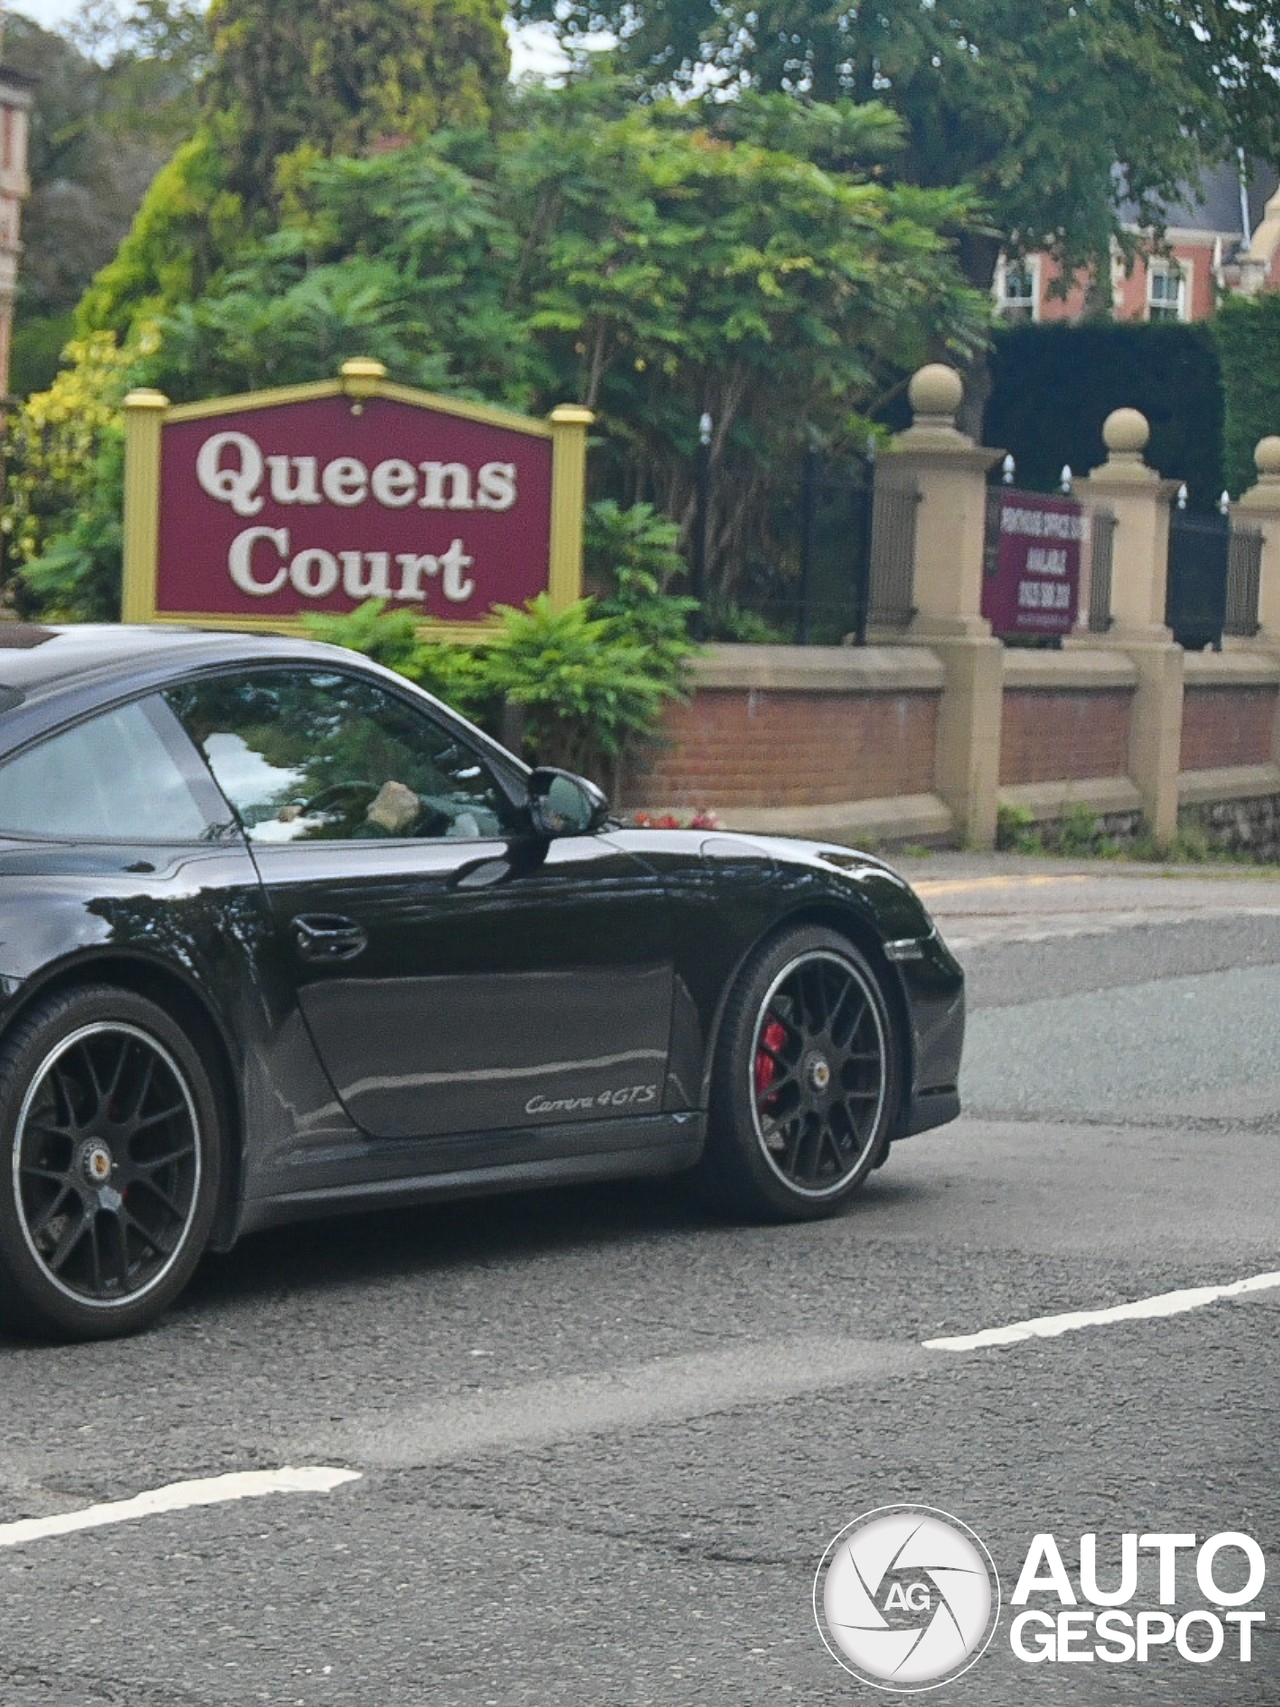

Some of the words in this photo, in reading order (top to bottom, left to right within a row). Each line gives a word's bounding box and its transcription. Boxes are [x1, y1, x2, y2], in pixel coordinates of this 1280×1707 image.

[196, 430, 517, 517] Queens
[228, 525, 475, 602] Court
[525, 1095, 594, 1114] Carrera
